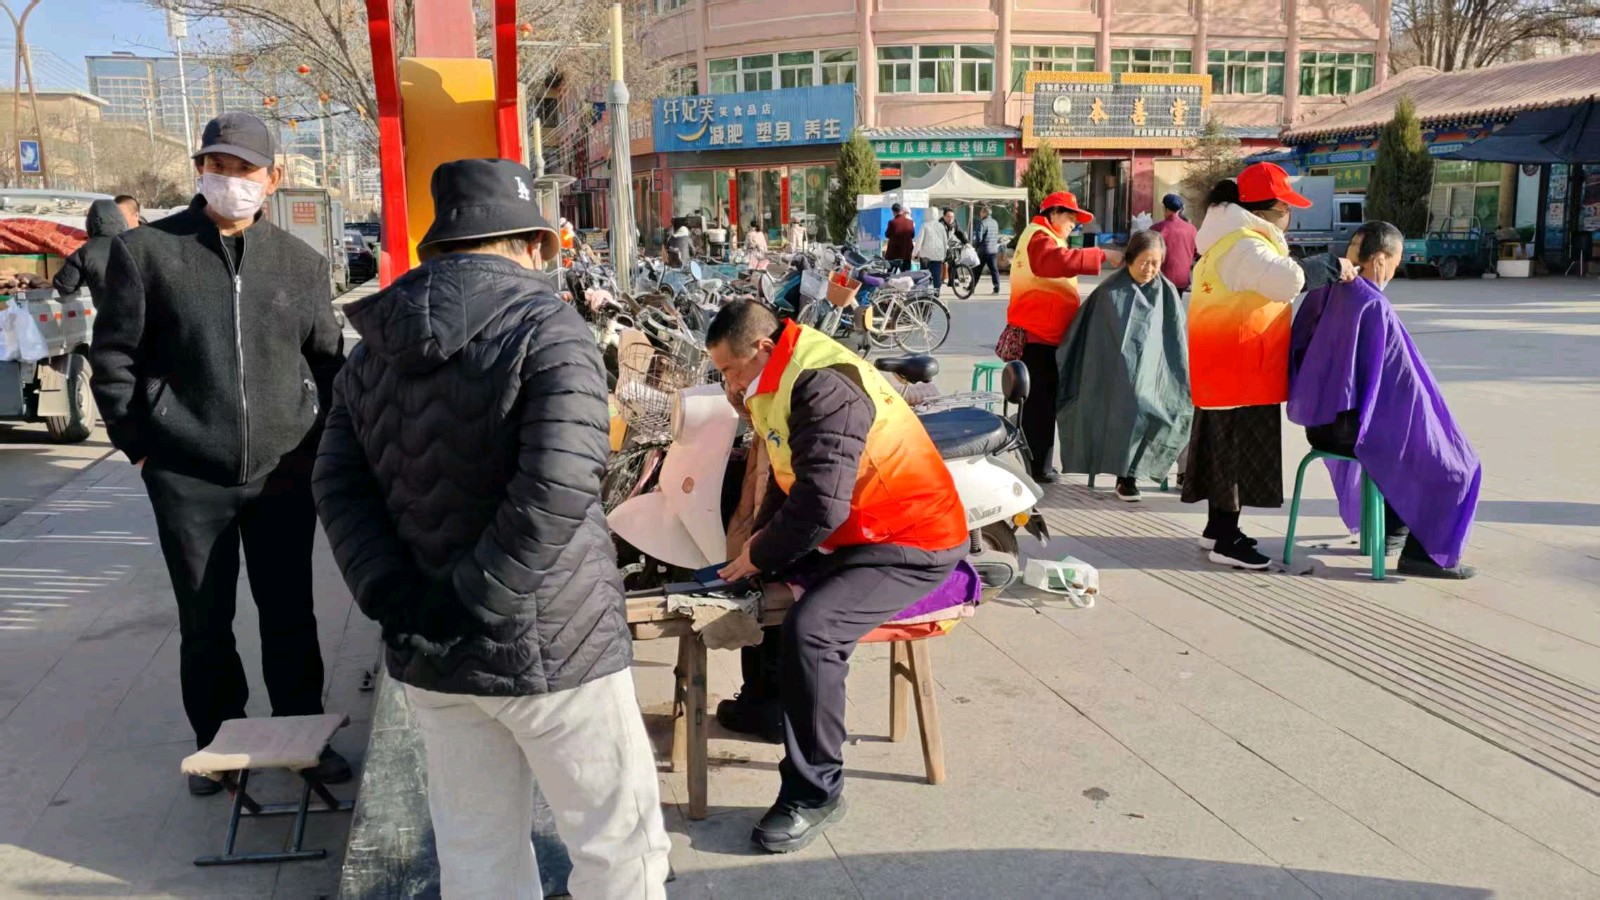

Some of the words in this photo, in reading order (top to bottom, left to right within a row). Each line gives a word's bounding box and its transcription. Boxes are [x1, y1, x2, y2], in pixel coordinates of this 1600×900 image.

[709, 124, 743, 145] 减肥
[756, 121, 792, 143] 塑身
[804, 118, 841, 140] 养生
